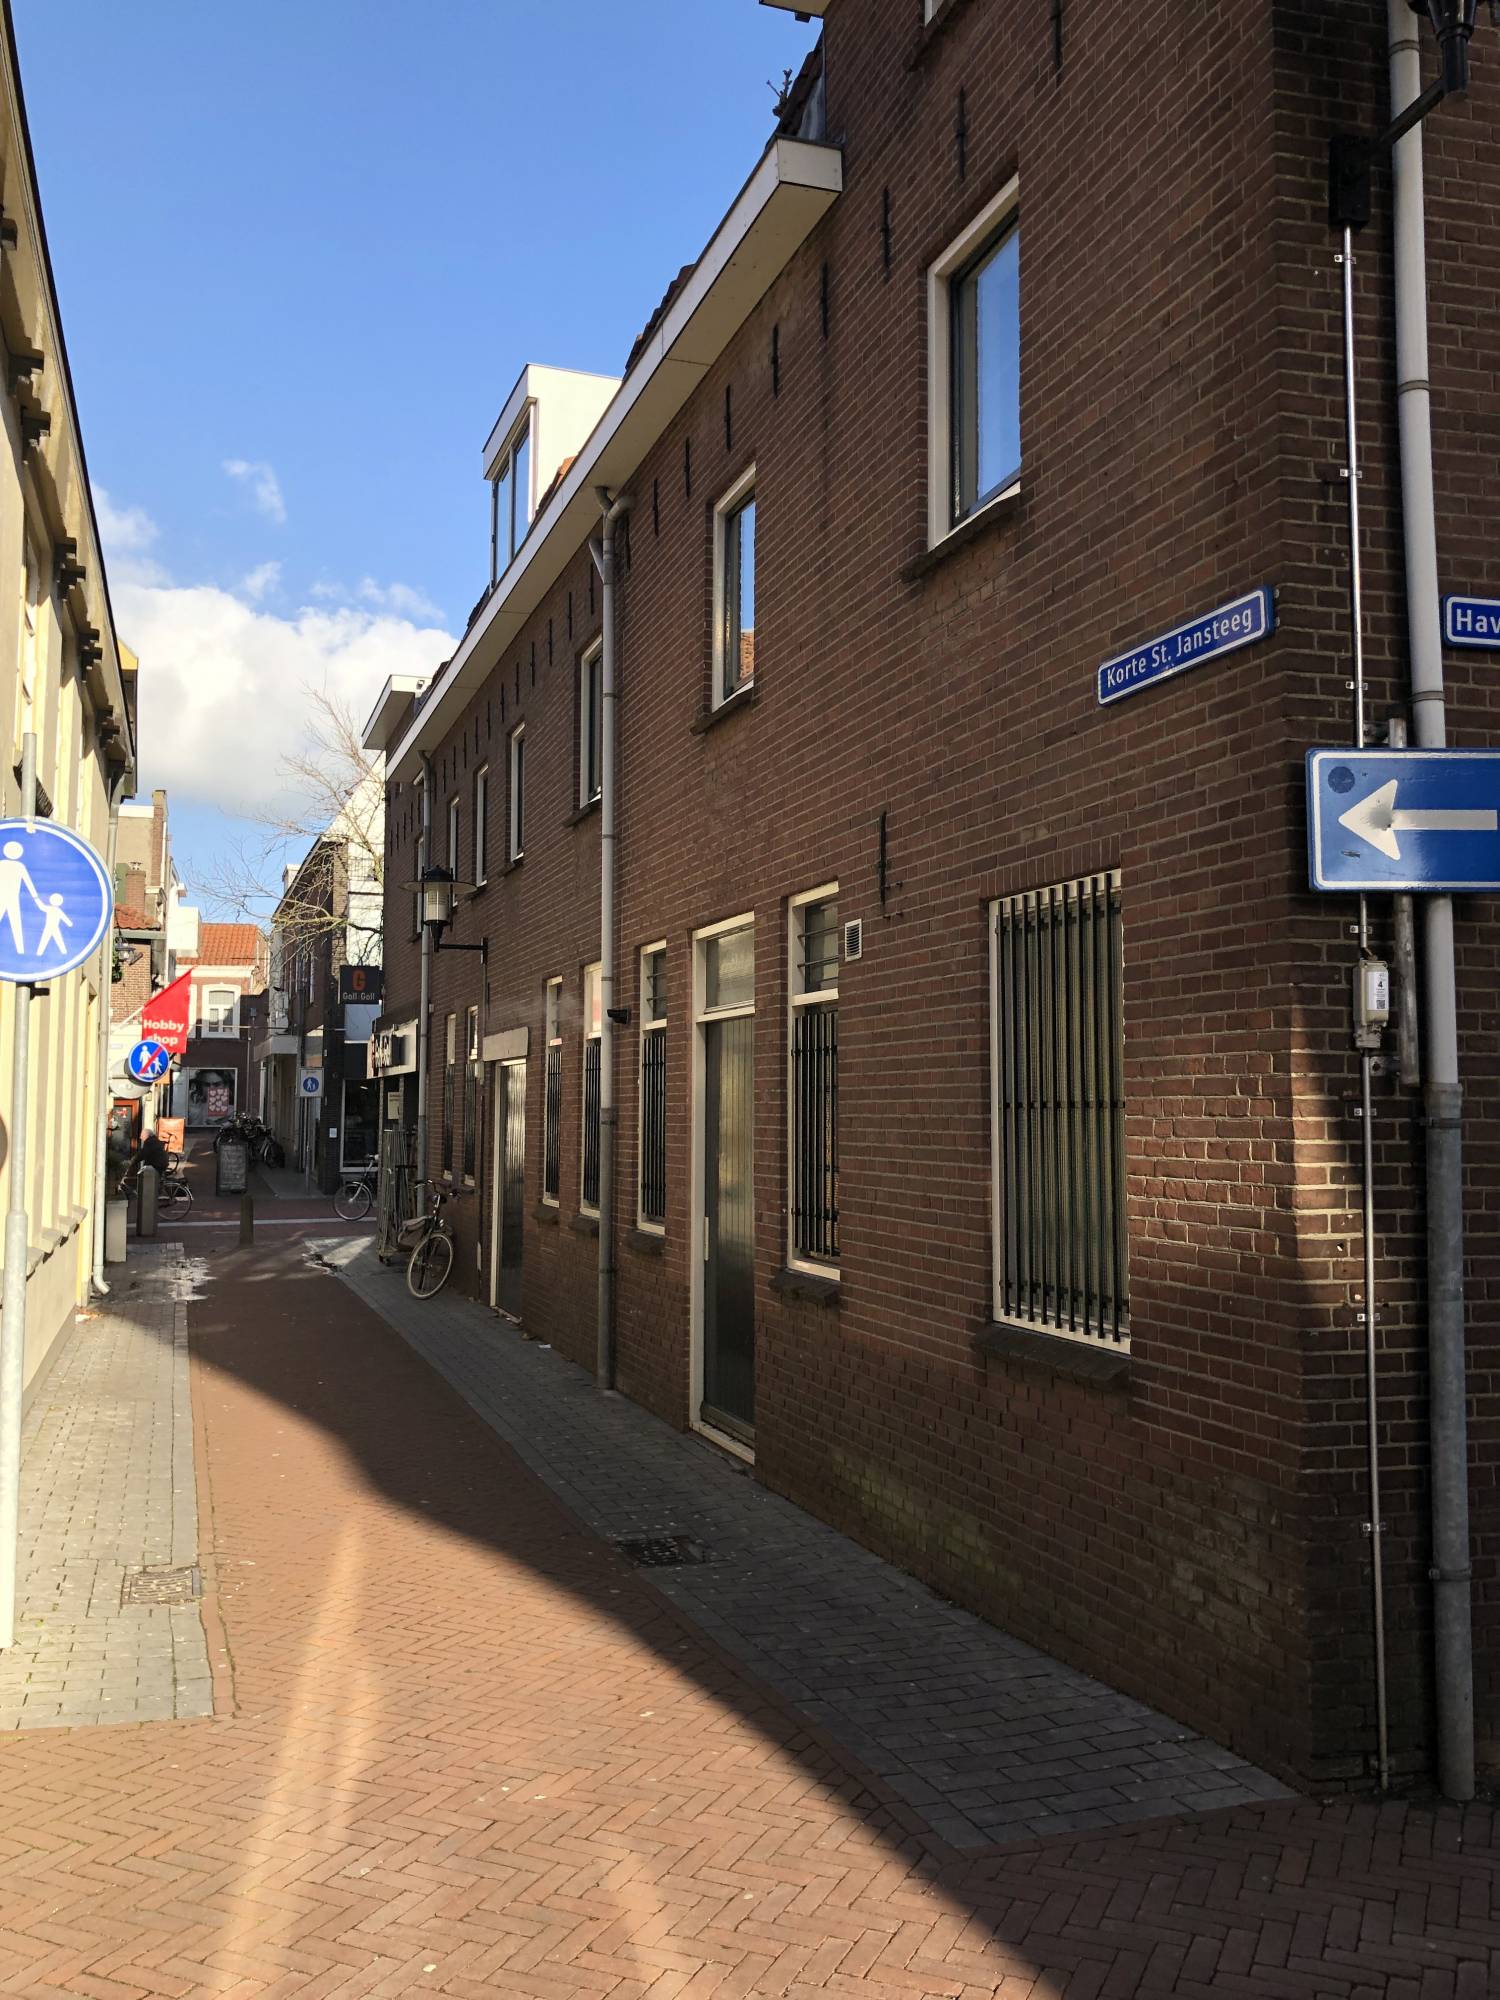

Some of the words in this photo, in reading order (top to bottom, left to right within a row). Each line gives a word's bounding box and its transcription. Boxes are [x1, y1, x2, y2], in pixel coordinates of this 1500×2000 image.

[1456, 608, 1500, 634] Hav
[1107, 657, 1147, 688] Korte
[1151, 646, 1172, 668] St.
[1176, 608, 1252, 657] Jansteeg
[143, 1019, 185, 1033] Hobby
